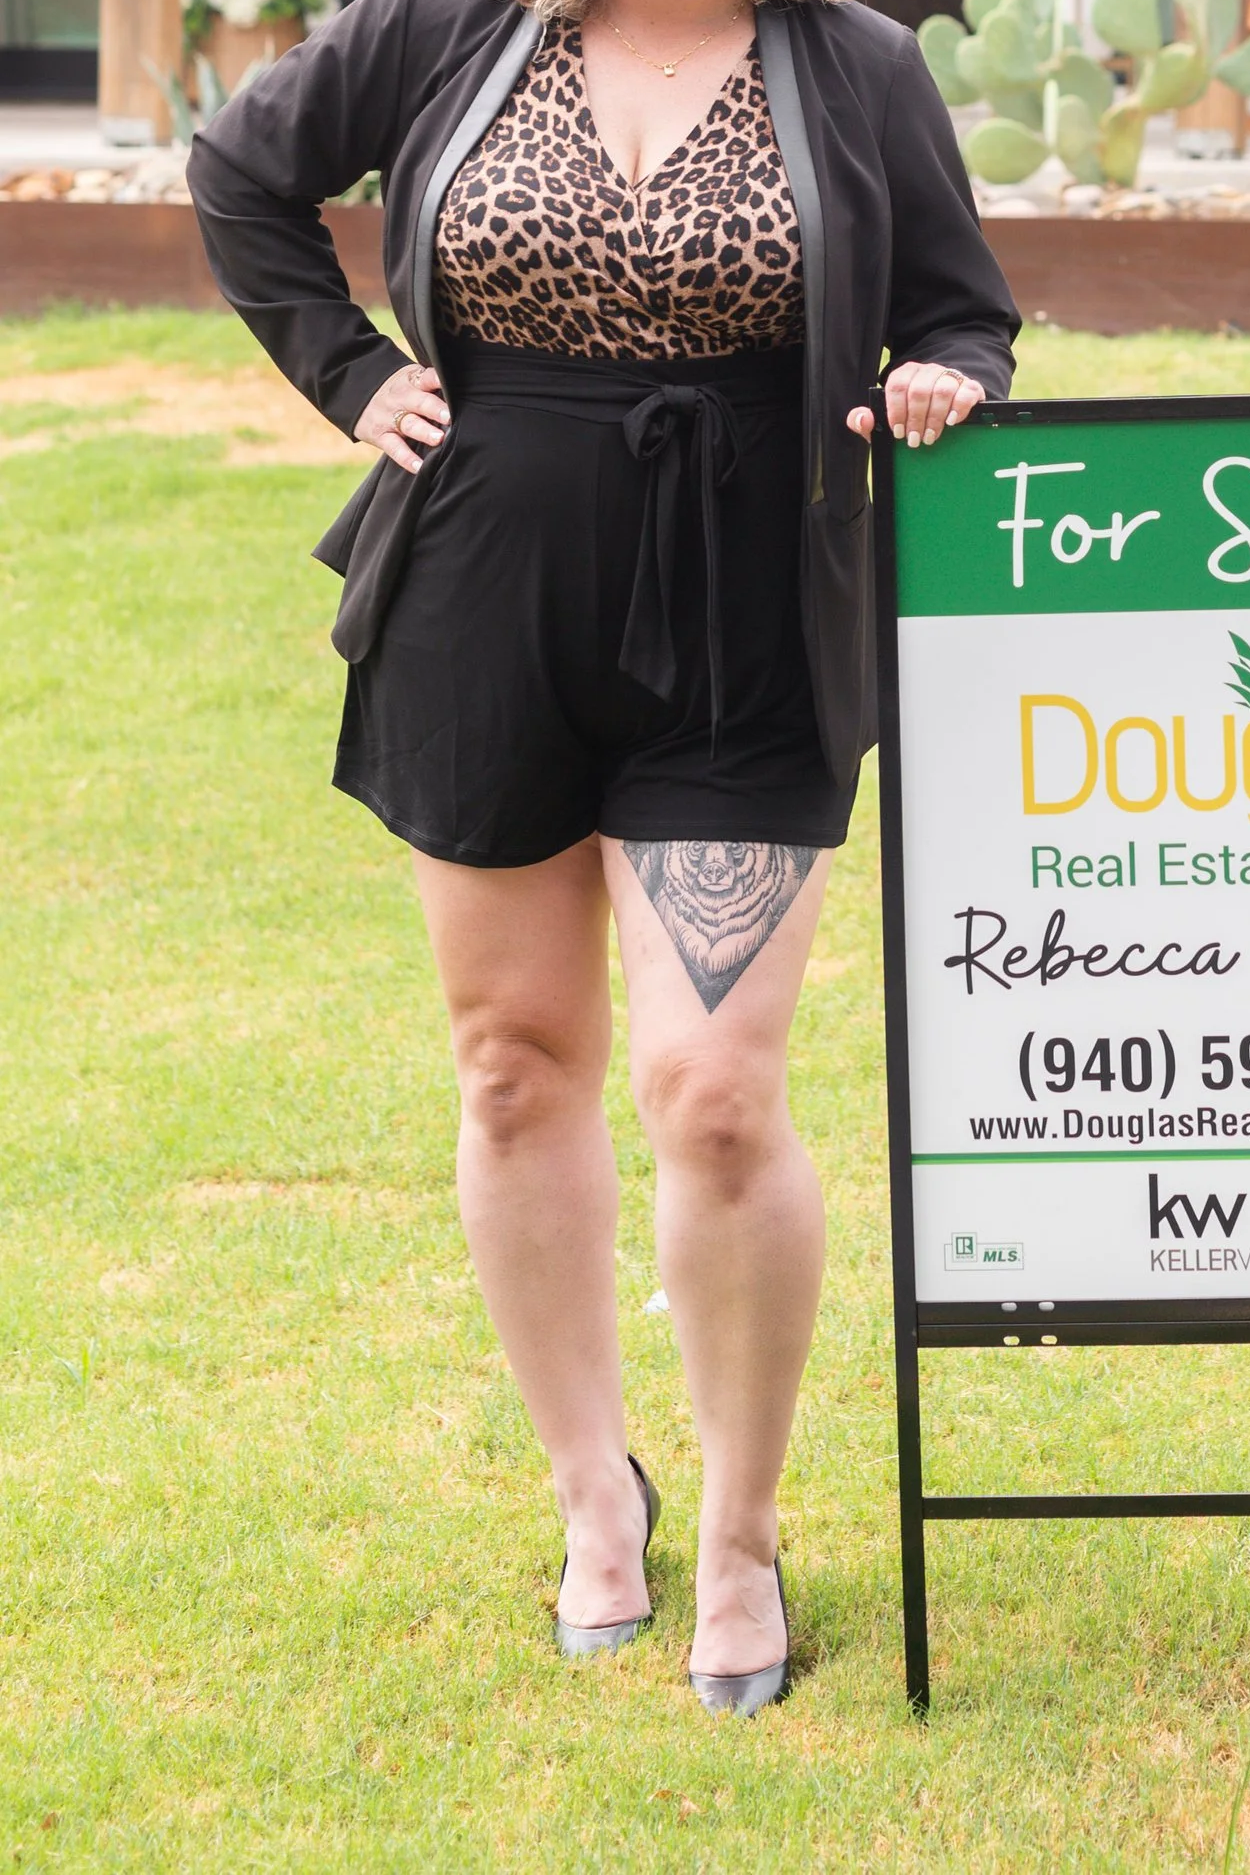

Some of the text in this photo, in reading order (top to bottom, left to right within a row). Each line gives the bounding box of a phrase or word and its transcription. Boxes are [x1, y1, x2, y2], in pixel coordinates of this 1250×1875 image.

[993, 461, 1161, 589] For
[1031, 841, 1136, 889] Real
[943, 905, 1241, 996] Rebecca
[1018, 1029, 1176, 1102] (940)
[1148, 1173, 1248, 1240] kw
